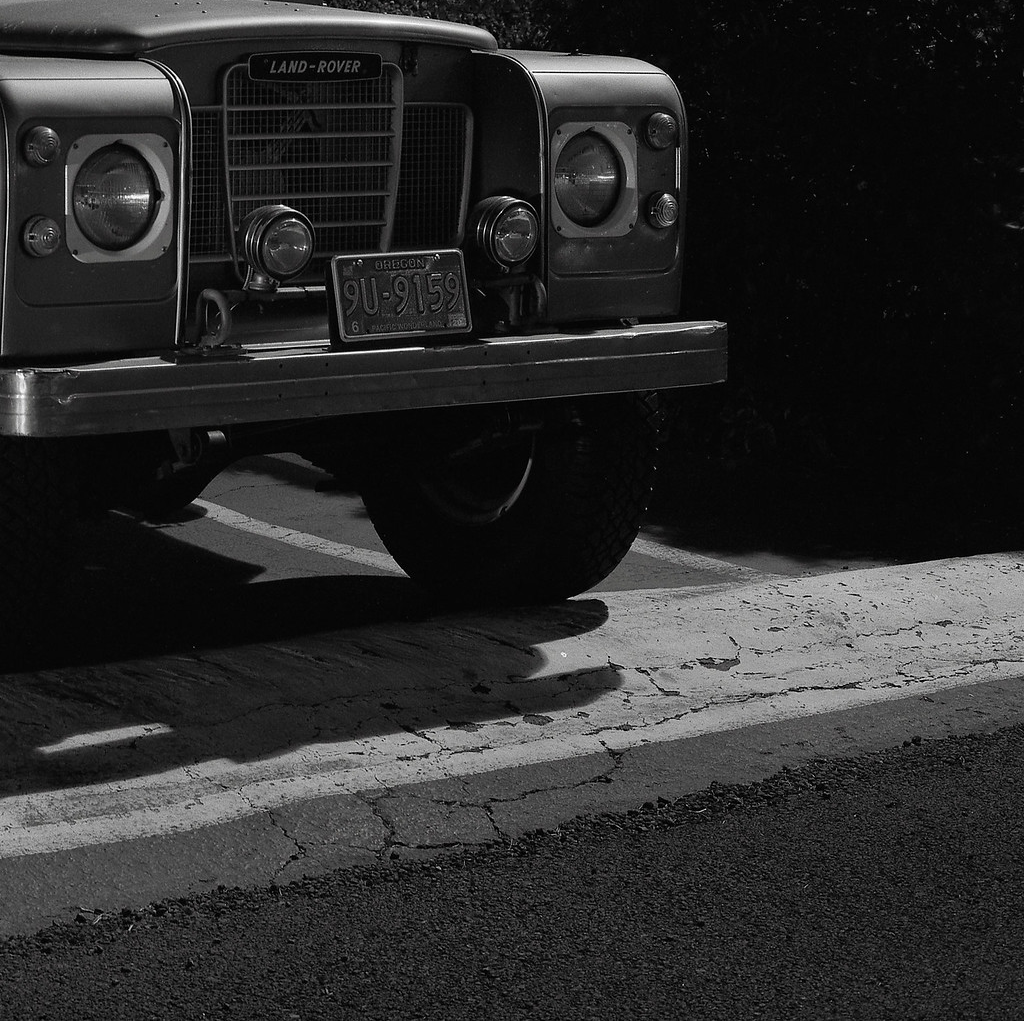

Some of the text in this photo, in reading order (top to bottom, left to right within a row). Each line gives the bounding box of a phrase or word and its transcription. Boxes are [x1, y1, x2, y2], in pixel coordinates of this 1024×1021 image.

[269, 59, 361, 74] LAND-ROVER
[375, 258, 426, 271] OREGON
[343, 273, 461, 316] 9U-9159
[351, 321, 359, 333] 6
